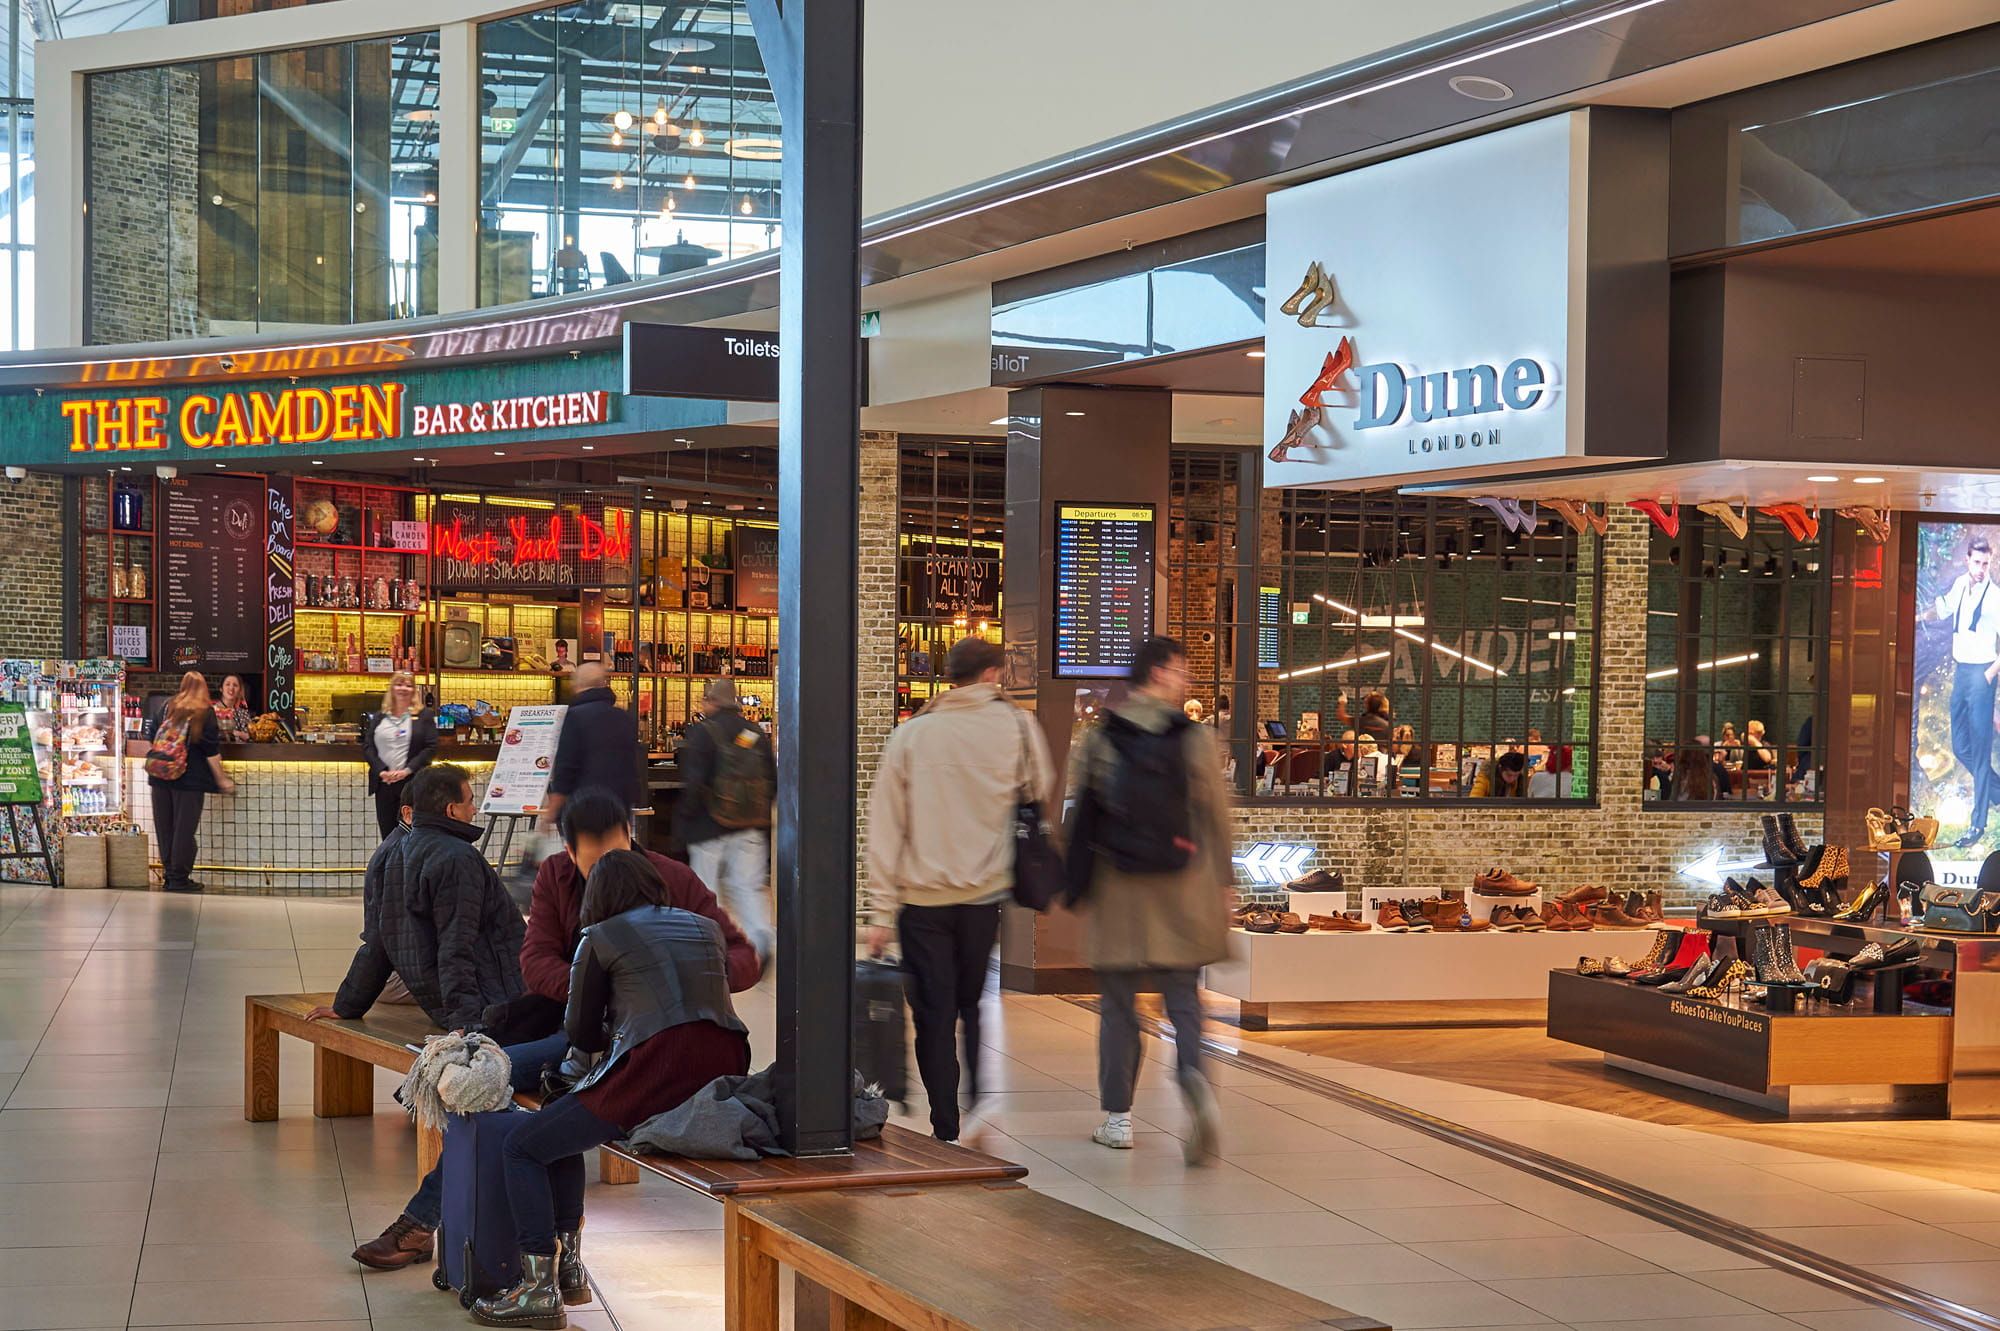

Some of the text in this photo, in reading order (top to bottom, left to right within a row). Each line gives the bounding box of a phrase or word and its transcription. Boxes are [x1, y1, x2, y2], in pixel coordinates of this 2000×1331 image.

[724, 337, 780, 358] Toilets
[1354, 358, 1545, 430] Dune
[62, 381, 608, 452] THE CAMDEN BAR & KITCHEN
[1409, 429, 1500, 454] LONDON
[267, 488, 294, 520] Take
[1074, 510, 1117, 518] Departures
[271, 520, 290, 540] on
[395, 531, 426, 540] CAMDEN
[401, 522, 417, 531] THE
[267, 534, 294, 561] Board
[435, 508, 633, 567] West Yard Deli
[268, 572, 293, 603] FRESH
[940, 578, 960, 597] ALL
[268, 603, 292, 624] DELI
[112, 627, 140, 636] COFFEE
[113, 637, 141, 646] JUICES
[118, 647, 140, 656] TO GO
[268, 644, 294, 670] Coffee
[100, 667, 120, 675] ONLY
[275, 671, 286, 688] to
[269, 690, 294, 711] GO!
[0, 715, 18, 725] ERY
[520, 709, 556, 717] BREAKFAST
[6, 766, 32, 775] ZONE
[1670, 1000, 1762, 1033] #ShoesToTakeYouPlaces
